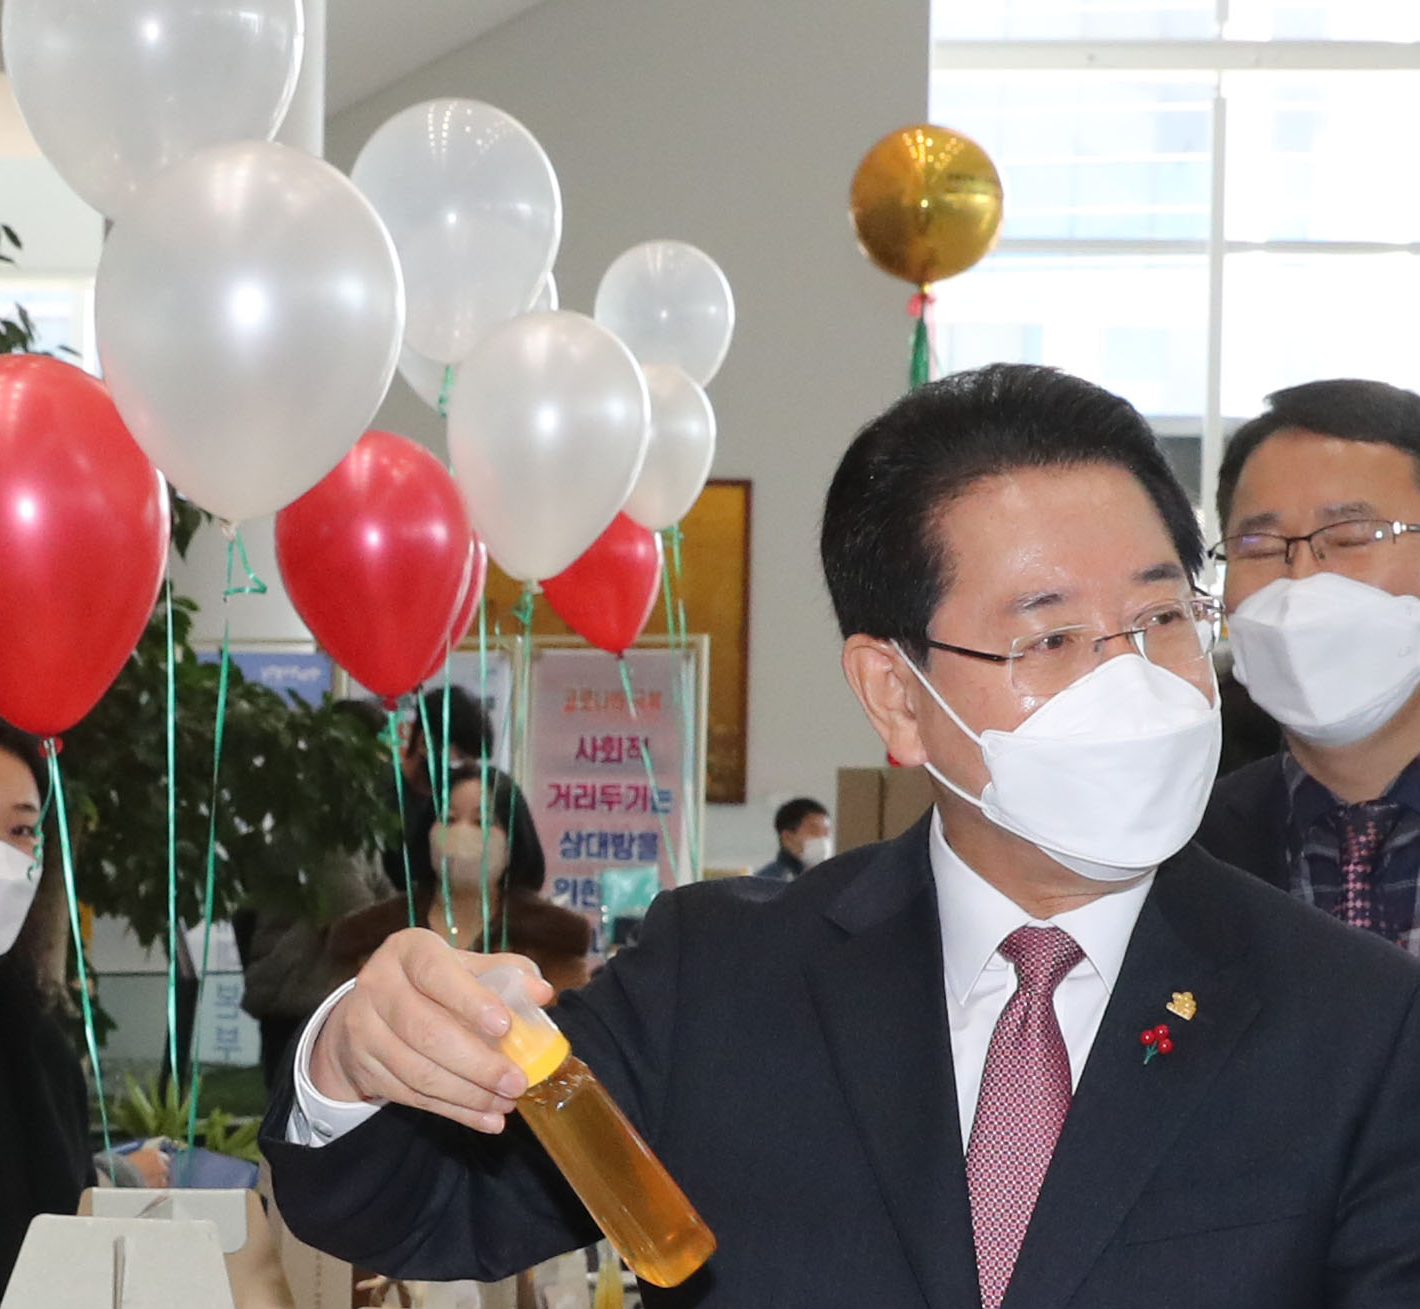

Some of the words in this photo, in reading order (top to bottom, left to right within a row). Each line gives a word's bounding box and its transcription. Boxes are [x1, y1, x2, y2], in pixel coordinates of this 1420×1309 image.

[575, 734, 649, 764] 사회적
[548, 783, 673, 814] 거리두기는
[560, 831, 658, 861] 상대방을
